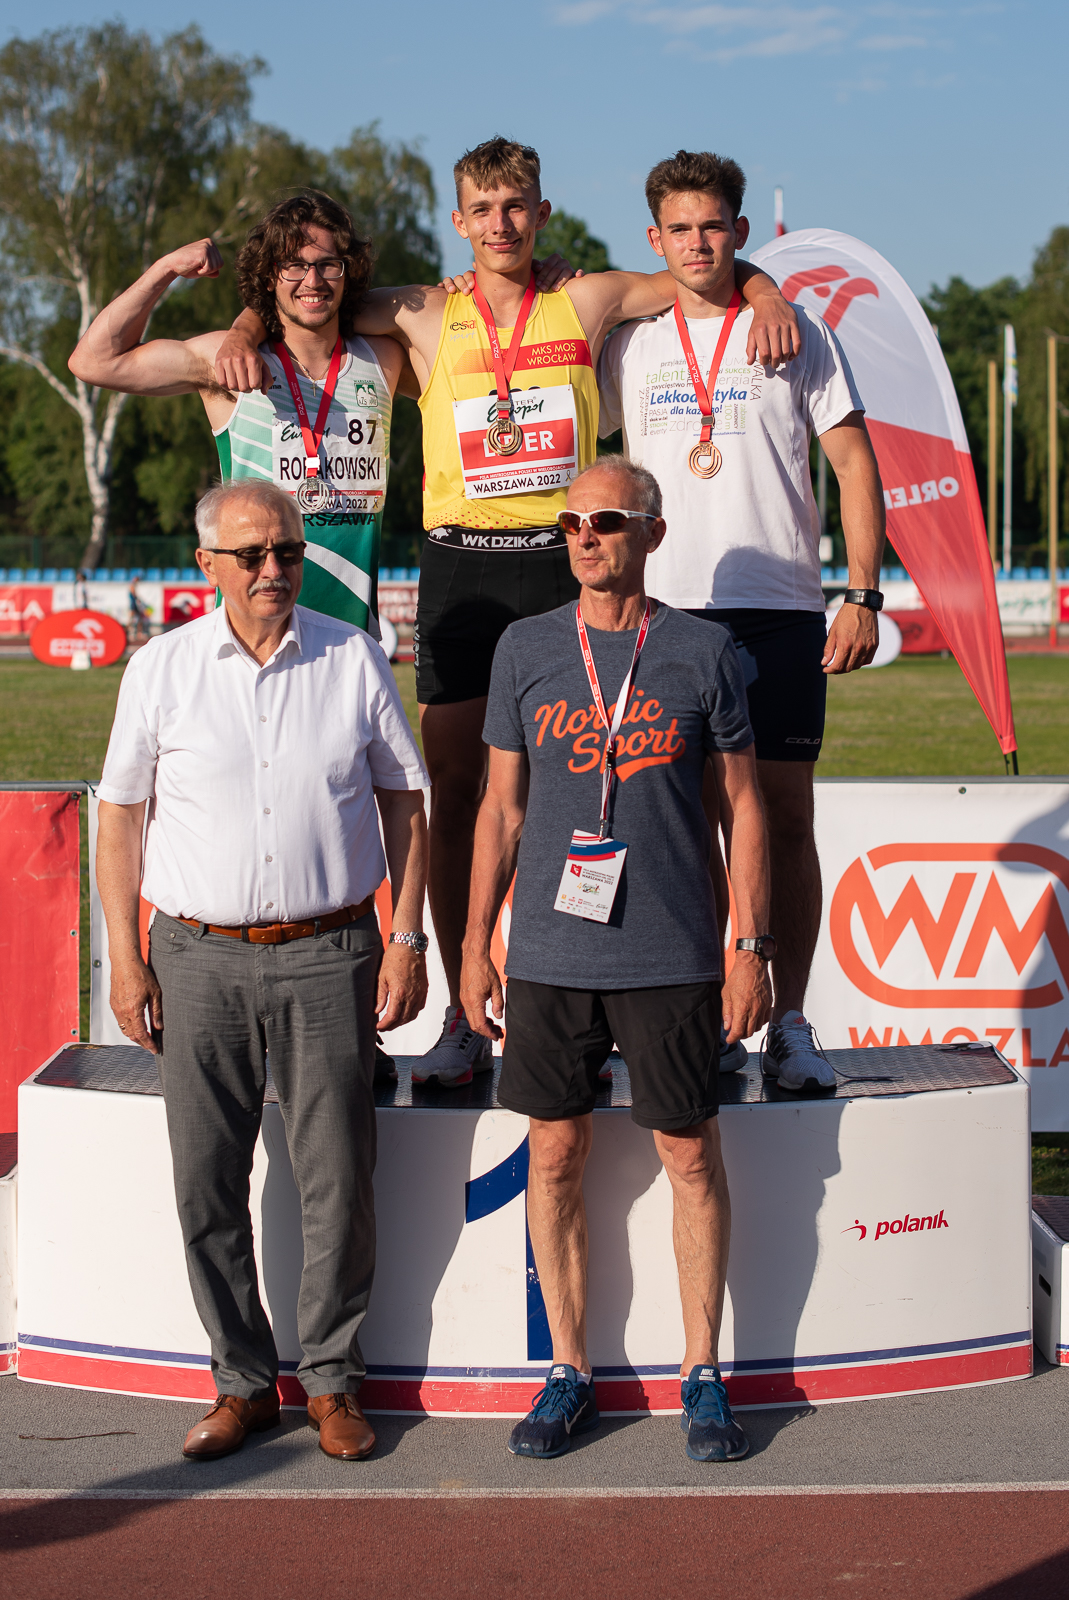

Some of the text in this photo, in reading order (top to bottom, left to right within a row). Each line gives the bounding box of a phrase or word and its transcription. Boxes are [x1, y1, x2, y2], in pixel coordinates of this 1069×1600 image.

[532, 342, 576, 356] MKS MOS
[526, 352, 576, 366] WROCŁAW
[646, 368, 686, 384] talent
[692, 366, 700, 384] PZLA
[649, 408, 668, 416] PASJA
[670, 406, 684, 415] dla
[348, 419, 376, 445] 87
[474, 474, 560, 494] WARSZAWA 2022
[346, 498, 368, 508] 2022
[462, 534, 530, 547] WK DZIK
[568, 718, 686, 776] Sport
[874, 1210, 949, 1240] polanik
